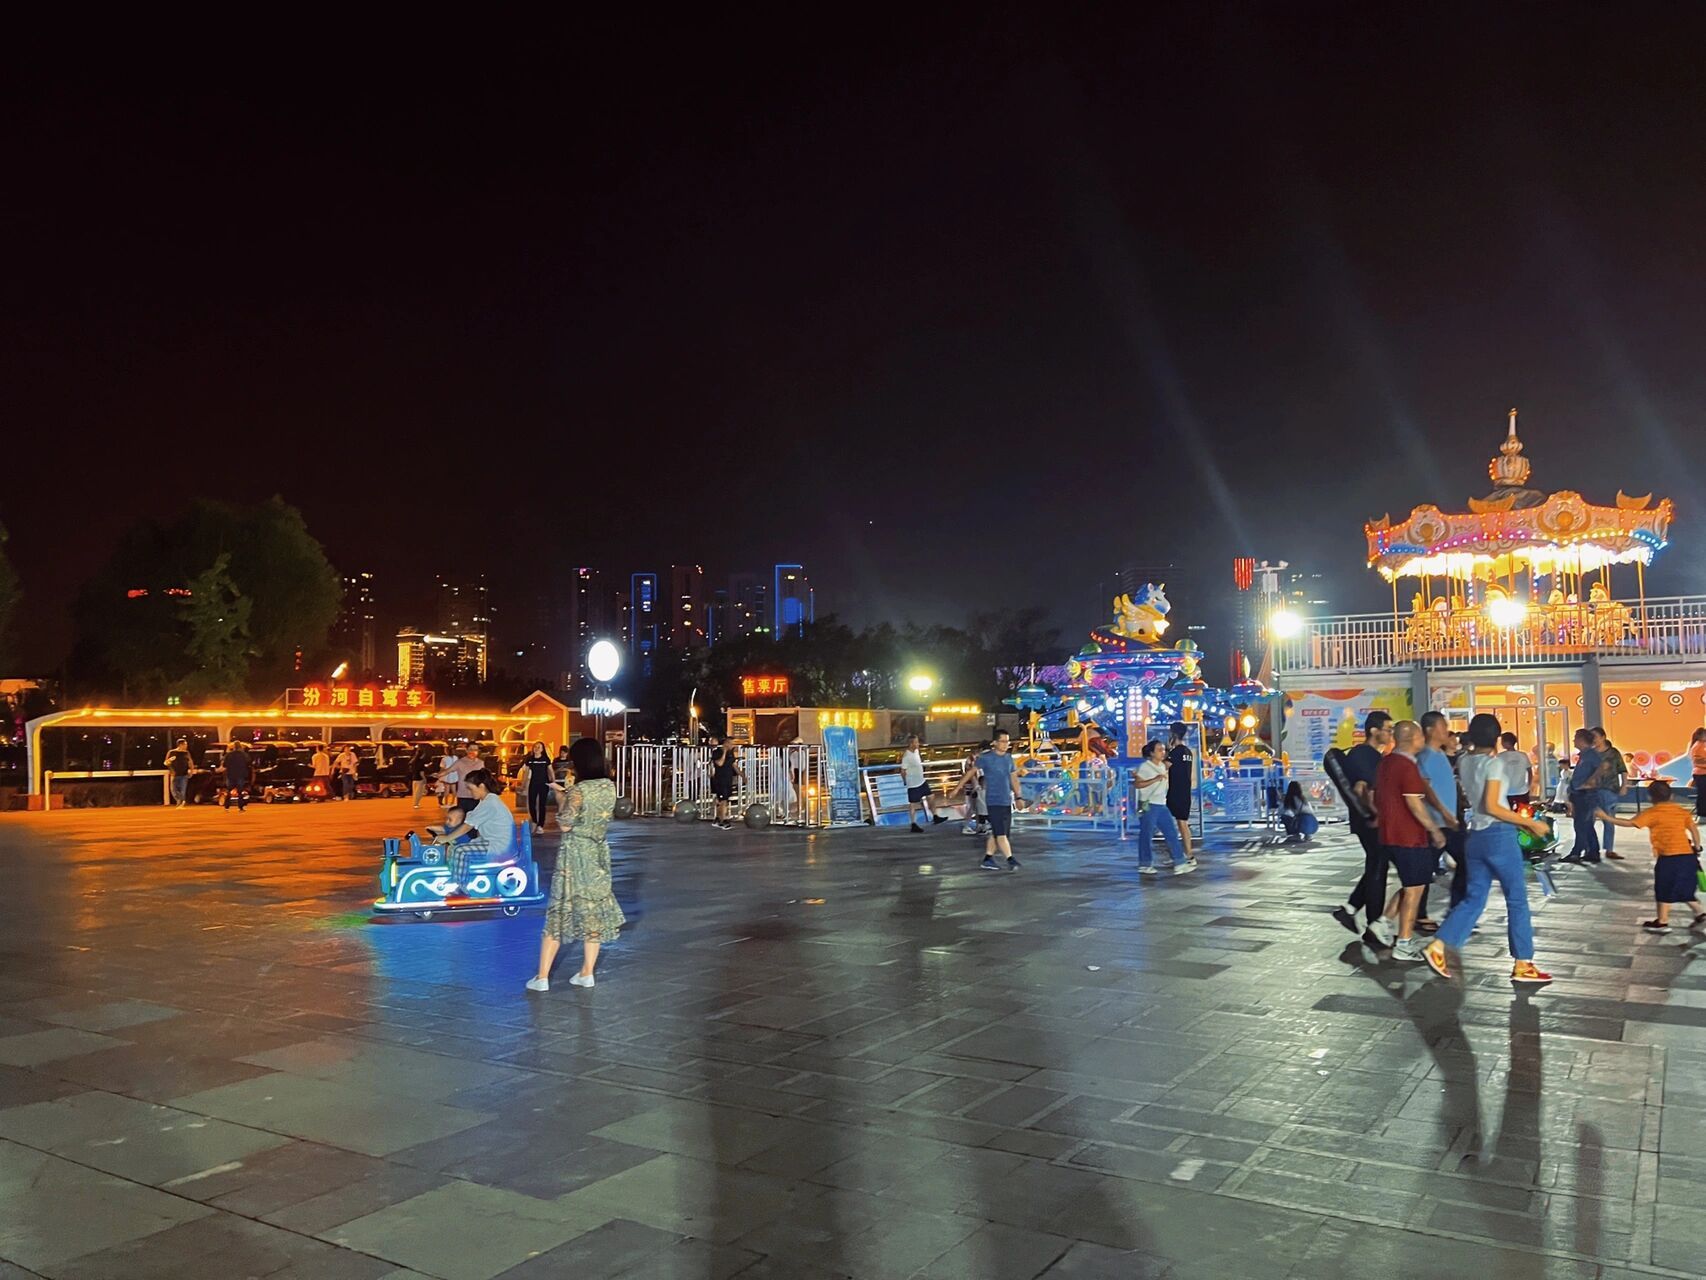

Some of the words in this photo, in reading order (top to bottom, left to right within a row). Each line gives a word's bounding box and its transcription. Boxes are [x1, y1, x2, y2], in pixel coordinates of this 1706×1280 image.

[742, 678, 788, 694] 售票厅
[303, 687, 422, 707] 汾河自驾车
